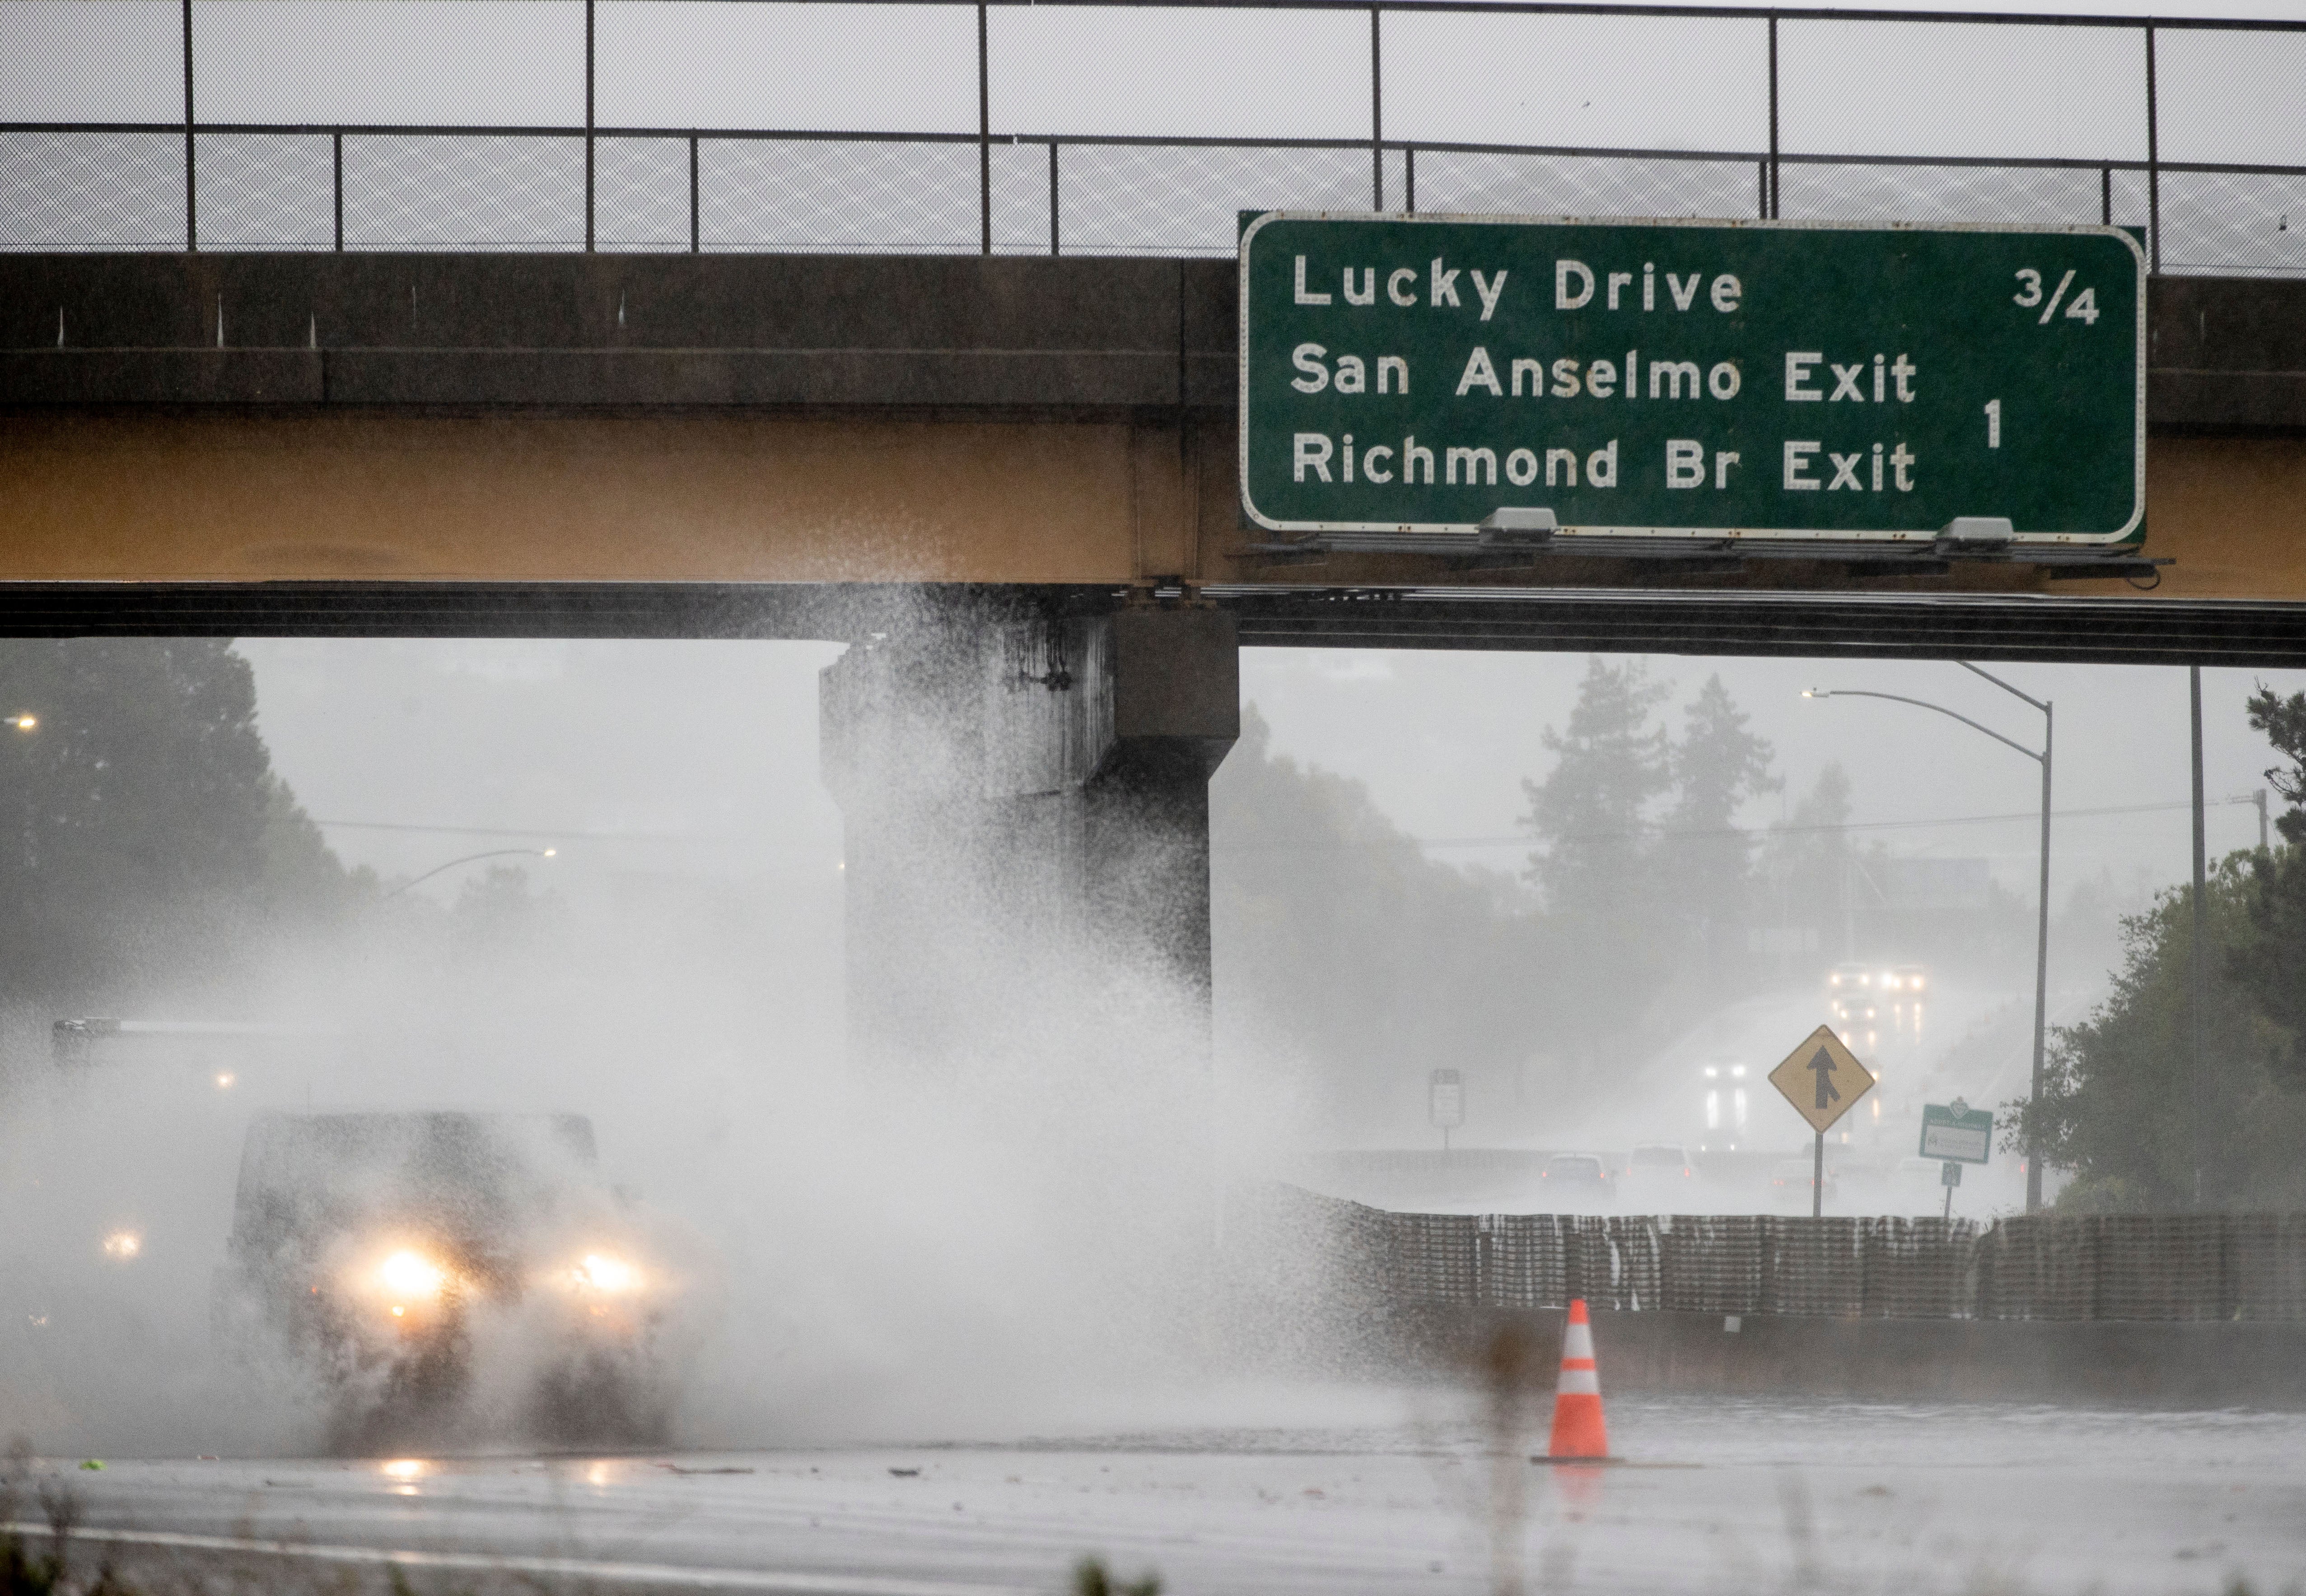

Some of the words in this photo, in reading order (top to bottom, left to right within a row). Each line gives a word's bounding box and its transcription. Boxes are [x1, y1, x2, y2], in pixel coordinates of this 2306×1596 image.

[1295, 256, 1507, 320] Lucky
[1556, 260, 1741, 312] Drive
[2013, 269, 2099, 324] 3/4
[1291, 343, 1408, 394] San
[1456, 347, 1740, 400] Anselmo
[1786, 352, 1915, 402] Exit
[1984, 400, 2000, 447] 1
[1294, 433, 1618, 488] Richmond
[1666, 440, 1739, 488] Br
[1784, 441, 1914, 490] Exit
